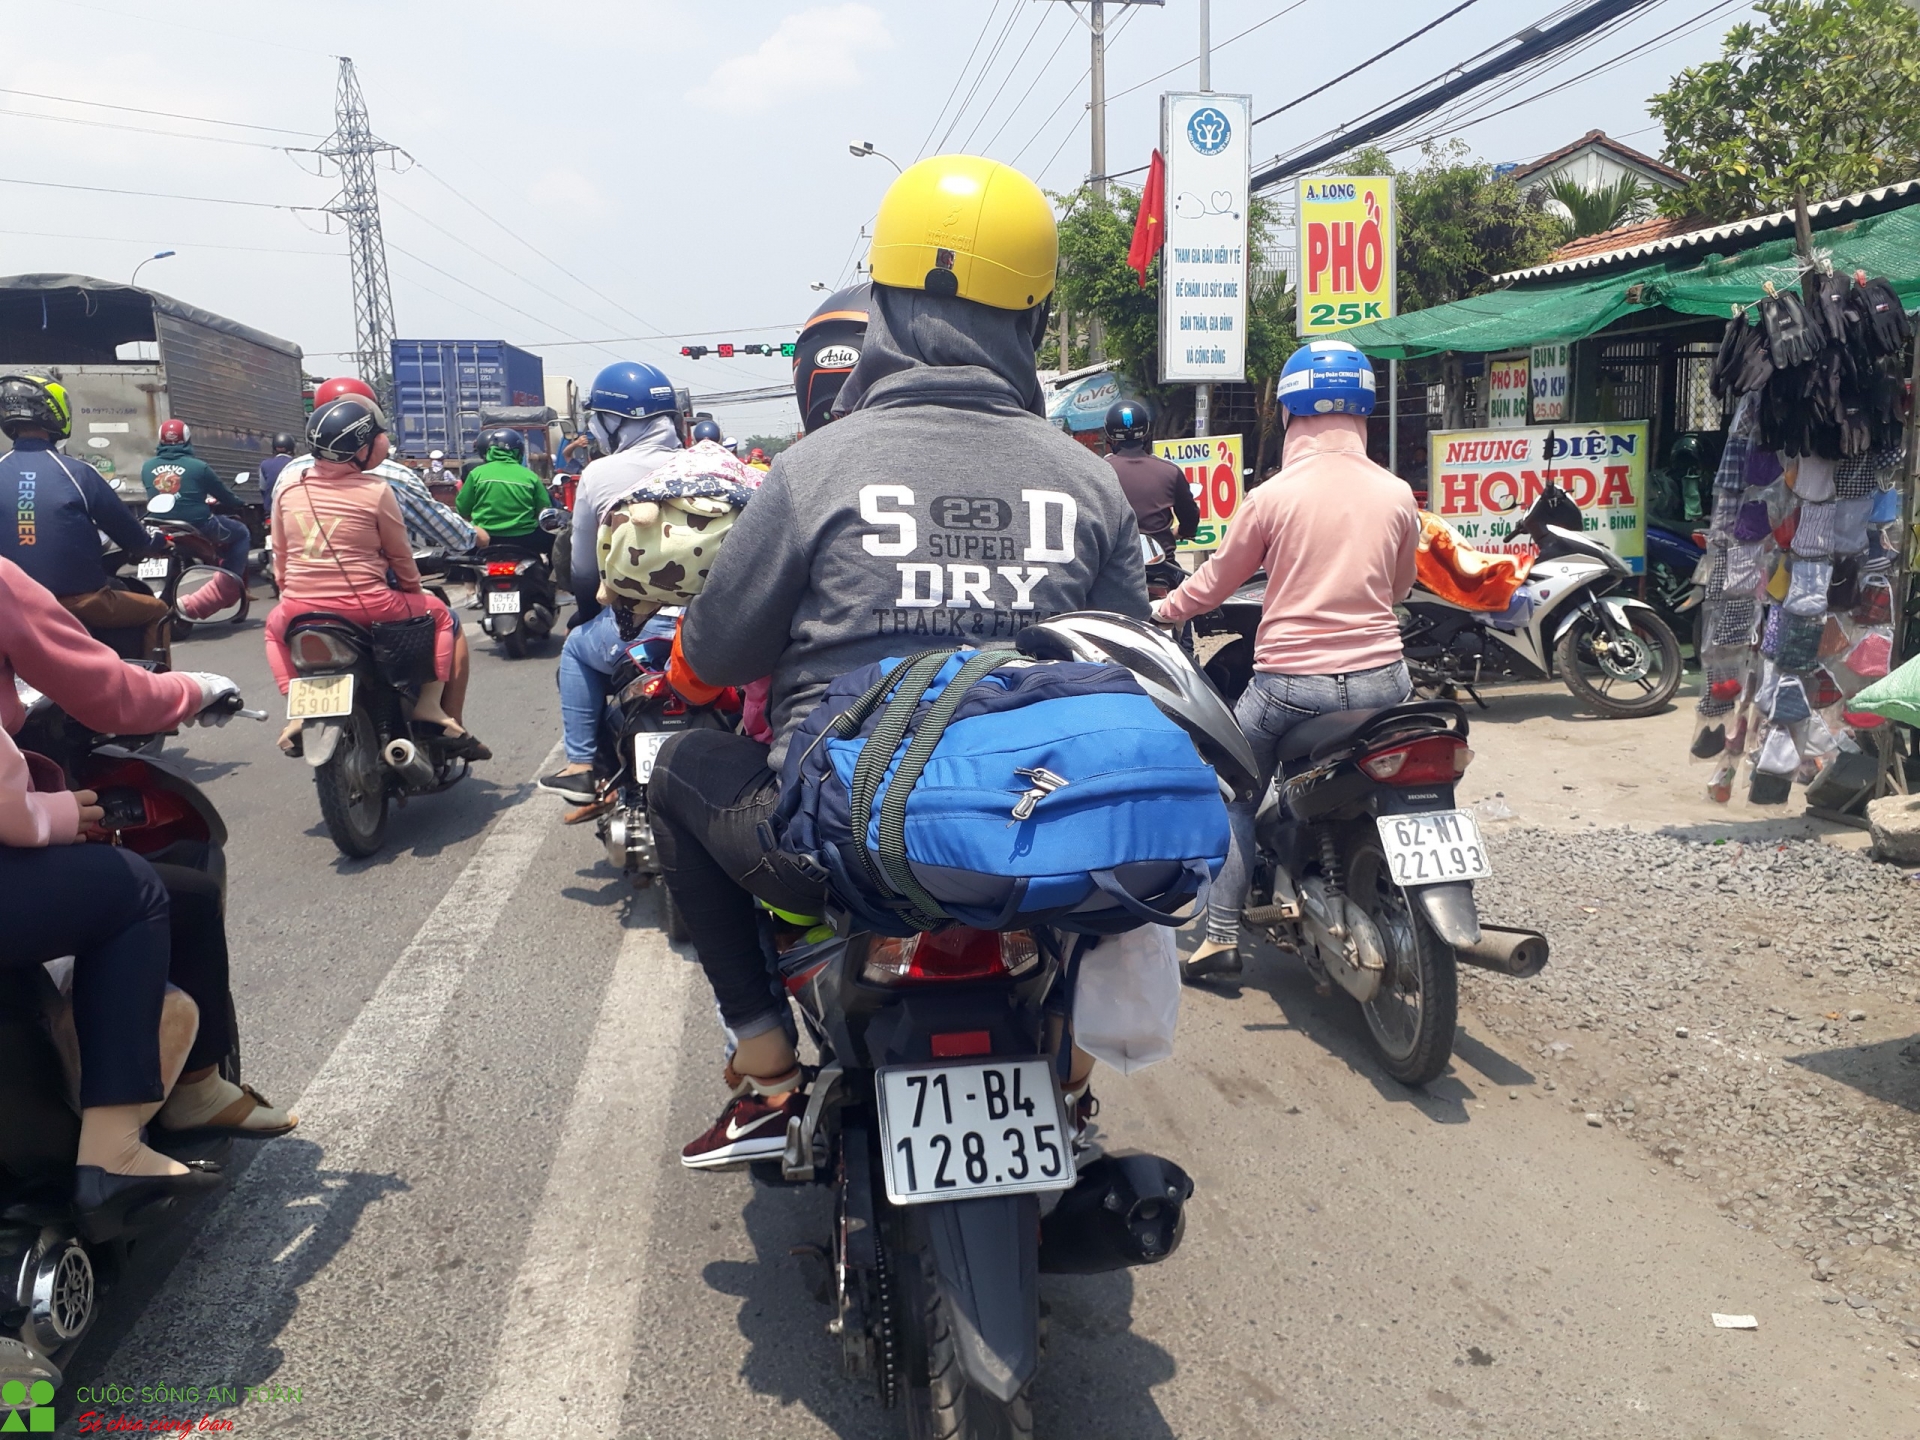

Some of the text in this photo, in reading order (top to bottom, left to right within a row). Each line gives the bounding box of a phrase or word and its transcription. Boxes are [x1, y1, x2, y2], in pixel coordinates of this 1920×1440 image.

[1306, 183, 1355, 199] A. LONG
[1174, 243, 1242, 265] THAM GIA BẢO HIỂM Y TẾ
[1308, 191, 1382, 293] PHỞ
[1175, 277, 1184, 298] ĐỂ
[1184, 279, 1201, 298] CHĂM
[1201, 282, 1209, 298] LO
[1209, 279, 1223, 298] SỨC
[1180, 310, 1234, 334] BẢN THÂN, GIA ĐÌNH
[1309, 302, 1383, 326] 25K
[820, 349, 854, 363] Asia
[1186, 344, 1226, 368] VÀ CỘNG ĐỒNG
[1491, 362, 1527, 390] PHỞ BÒ
[1490, 391, 1528, 418] BÚN BÒ
[1163, 443, 1211, 460] A. LONG
[1445, 430, 1638, 463] NHUNG ĐIỆN
[151, 464, 186, 476] TOKYO
[1184, 440, 1237, 520] HỞ
[1440, 465, 1636, 515] HONDA
[17, 471, 37, 546] PERSEIER
[858, 484, 1078, 564] S 23 D
[1490, 516, 1512, 537] SỬA
[1583, 513, 1599, 531] ÈN
[1610, 511, 1637, 530] BÌNH
[928, 533, 1016, 560] SUPER
[895, 562, 1049, 610] DRY
[872, 609, 1061, 638] TRACK & FIE
[297, 695, 340, 715] 5901
[1394, 815, 1463, 847] 62-N1
[1394, 846, 1484, 880] 221.93
[906, 1067, 1036, 1128] 71-B4
[896, 1124, 1062, 1192] 128.35
